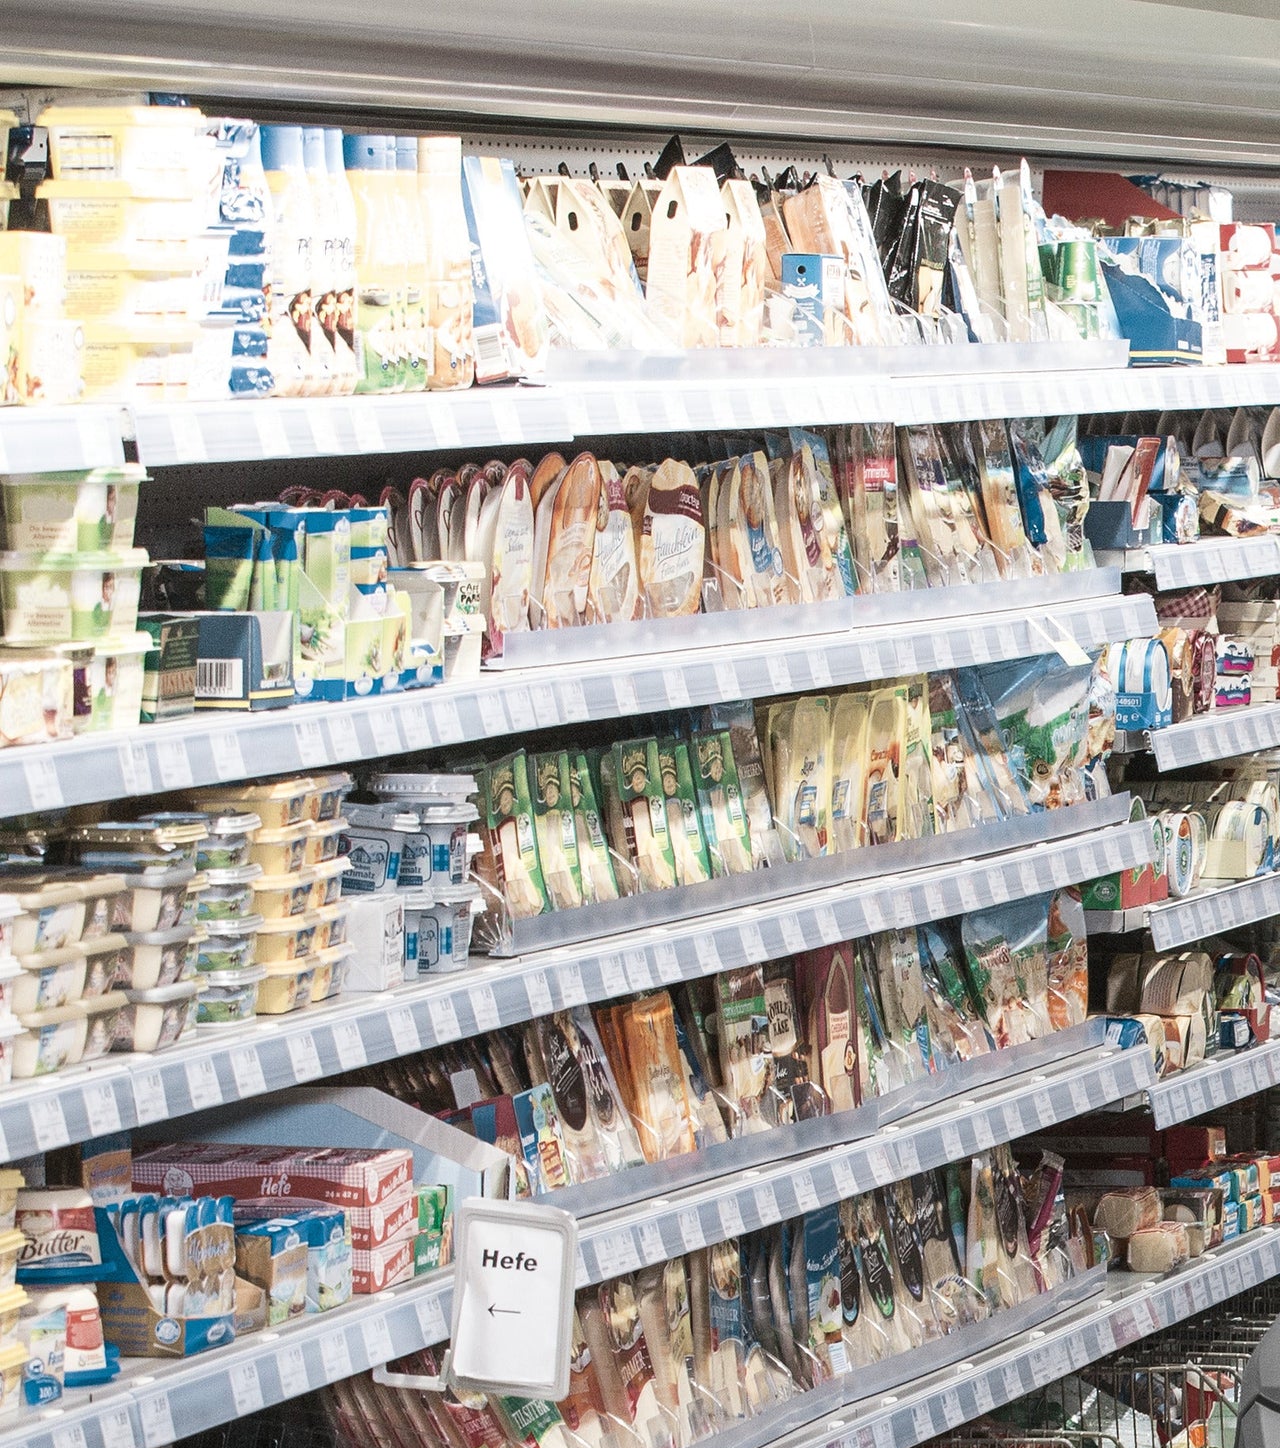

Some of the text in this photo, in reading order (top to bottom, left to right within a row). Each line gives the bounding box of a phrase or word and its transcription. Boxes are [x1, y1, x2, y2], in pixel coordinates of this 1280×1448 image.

[260, 1172, 291, 1198] Hefe
[342, 1189, 353, 1199] 42
[353, 1190, 361, 1201] g
[21, 1233, 85, 1260] Butter
[482, 1249, 538, 1272] Hefe
